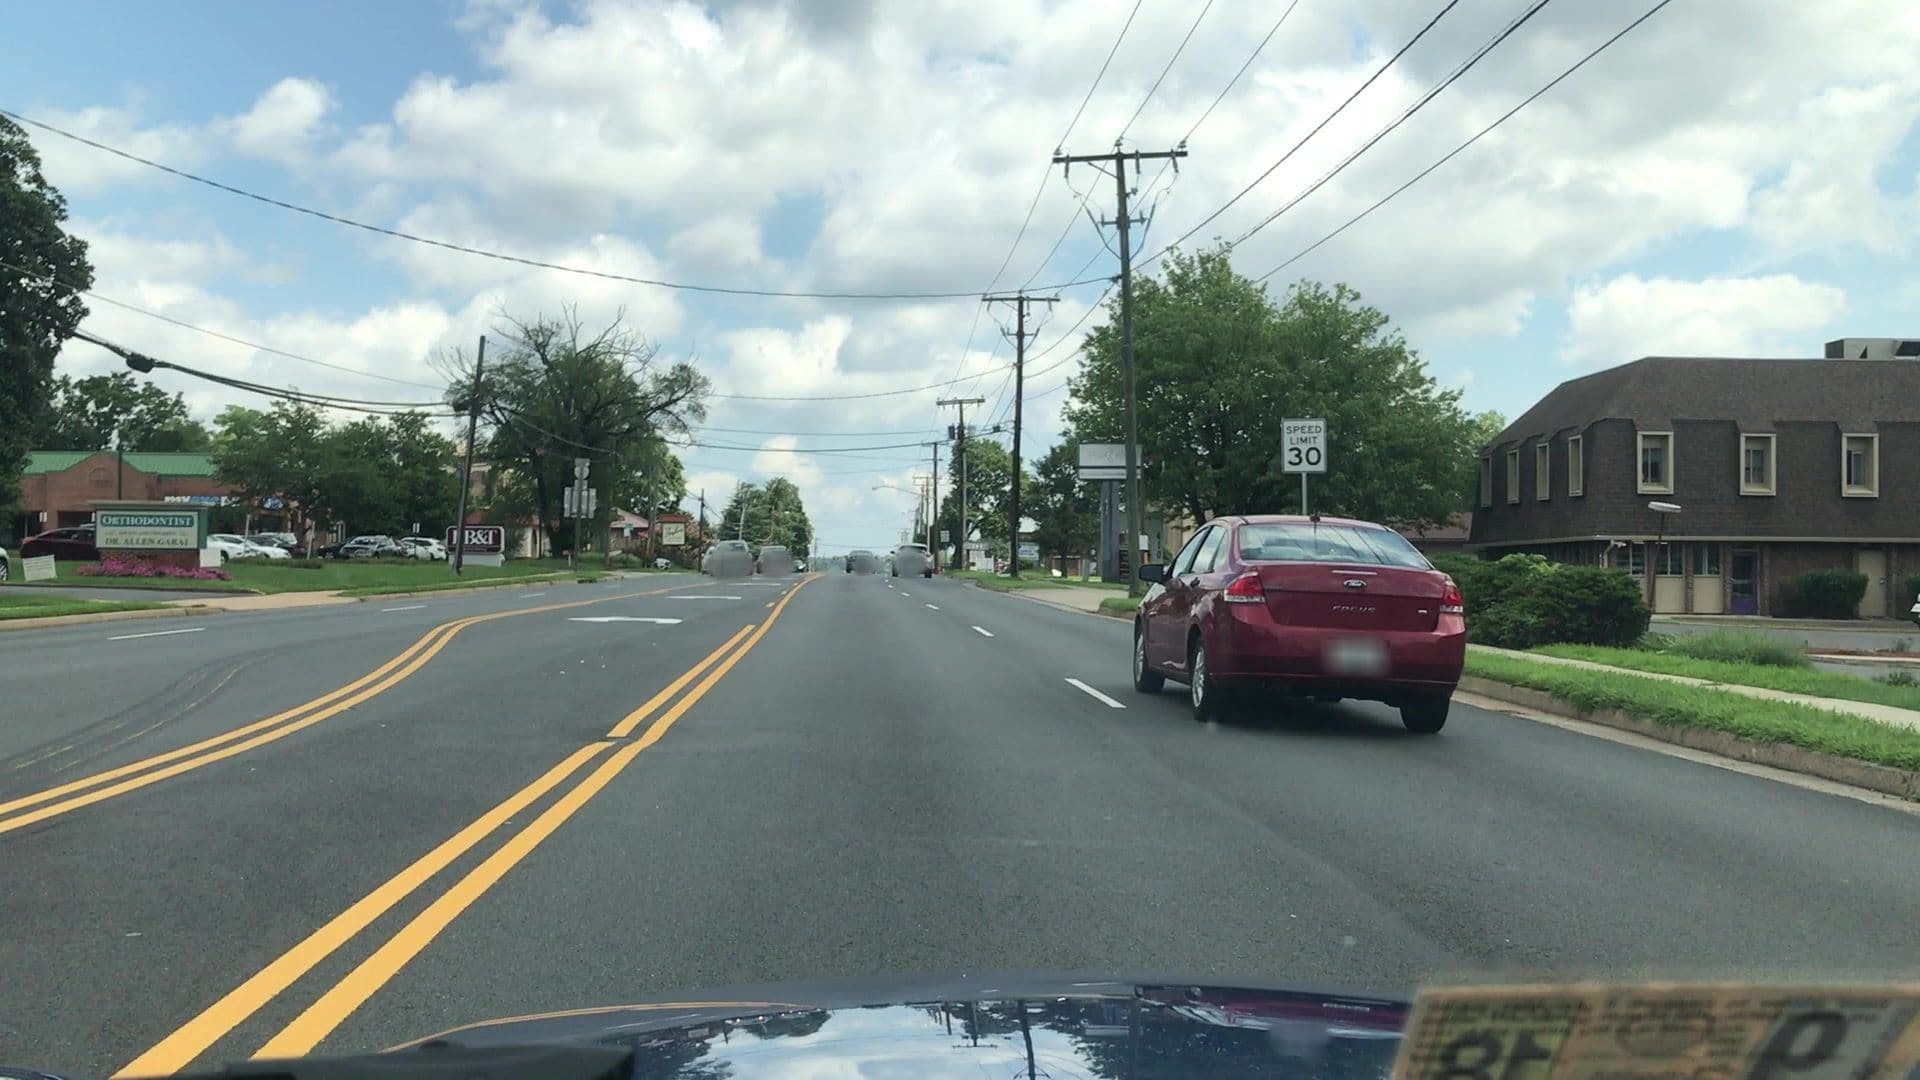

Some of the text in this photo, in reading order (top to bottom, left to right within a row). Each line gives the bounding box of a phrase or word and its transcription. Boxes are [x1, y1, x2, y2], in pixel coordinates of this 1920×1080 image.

[1286, 425, 1322, 434] SPEED
[1290, 436, 1317, 446] LIMIT
[1288, 447, 1321, 466] 30
[102, 515, 192, 526] ORTHODONTIST
